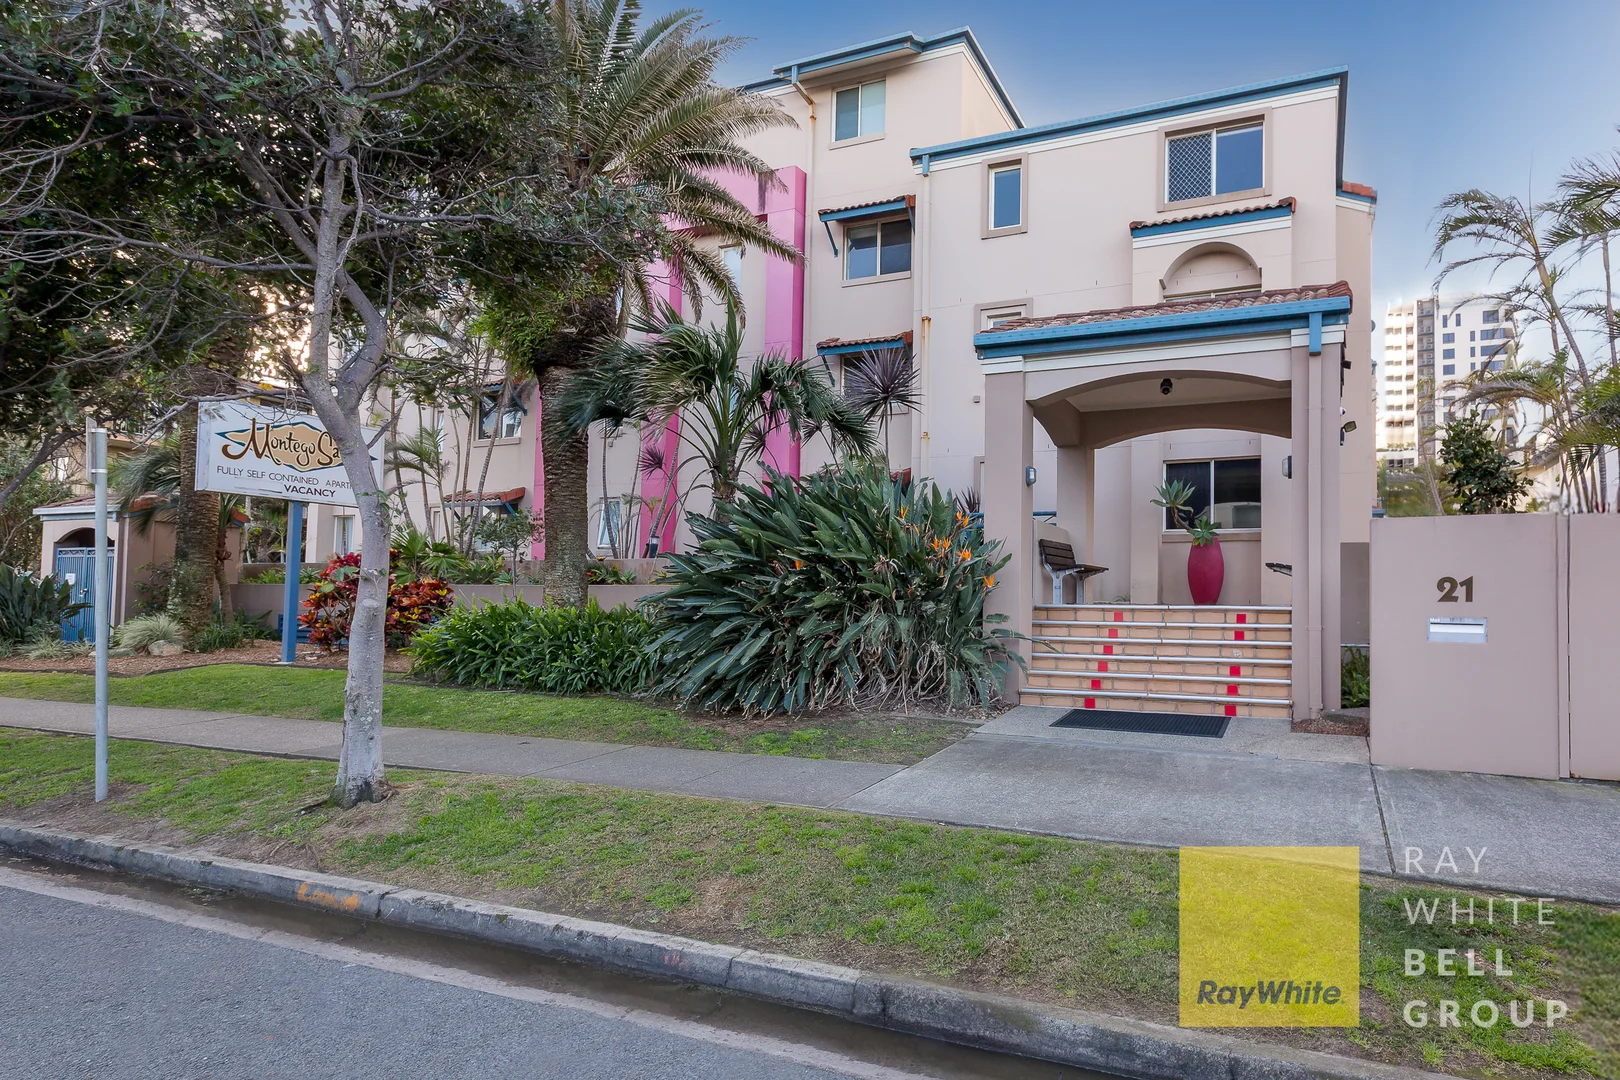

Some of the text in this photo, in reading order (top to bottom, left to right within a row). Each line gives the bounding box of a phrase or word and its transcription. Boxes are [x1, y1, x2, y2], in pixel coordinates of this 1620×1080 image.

[221, 418, 316, 466] Montego
[216, 466, 352, 490] FULLY SELF CONTAINED APART
[284, 484, 336, 498] VACANCY
[1437, 576, 1474, 602] 21
